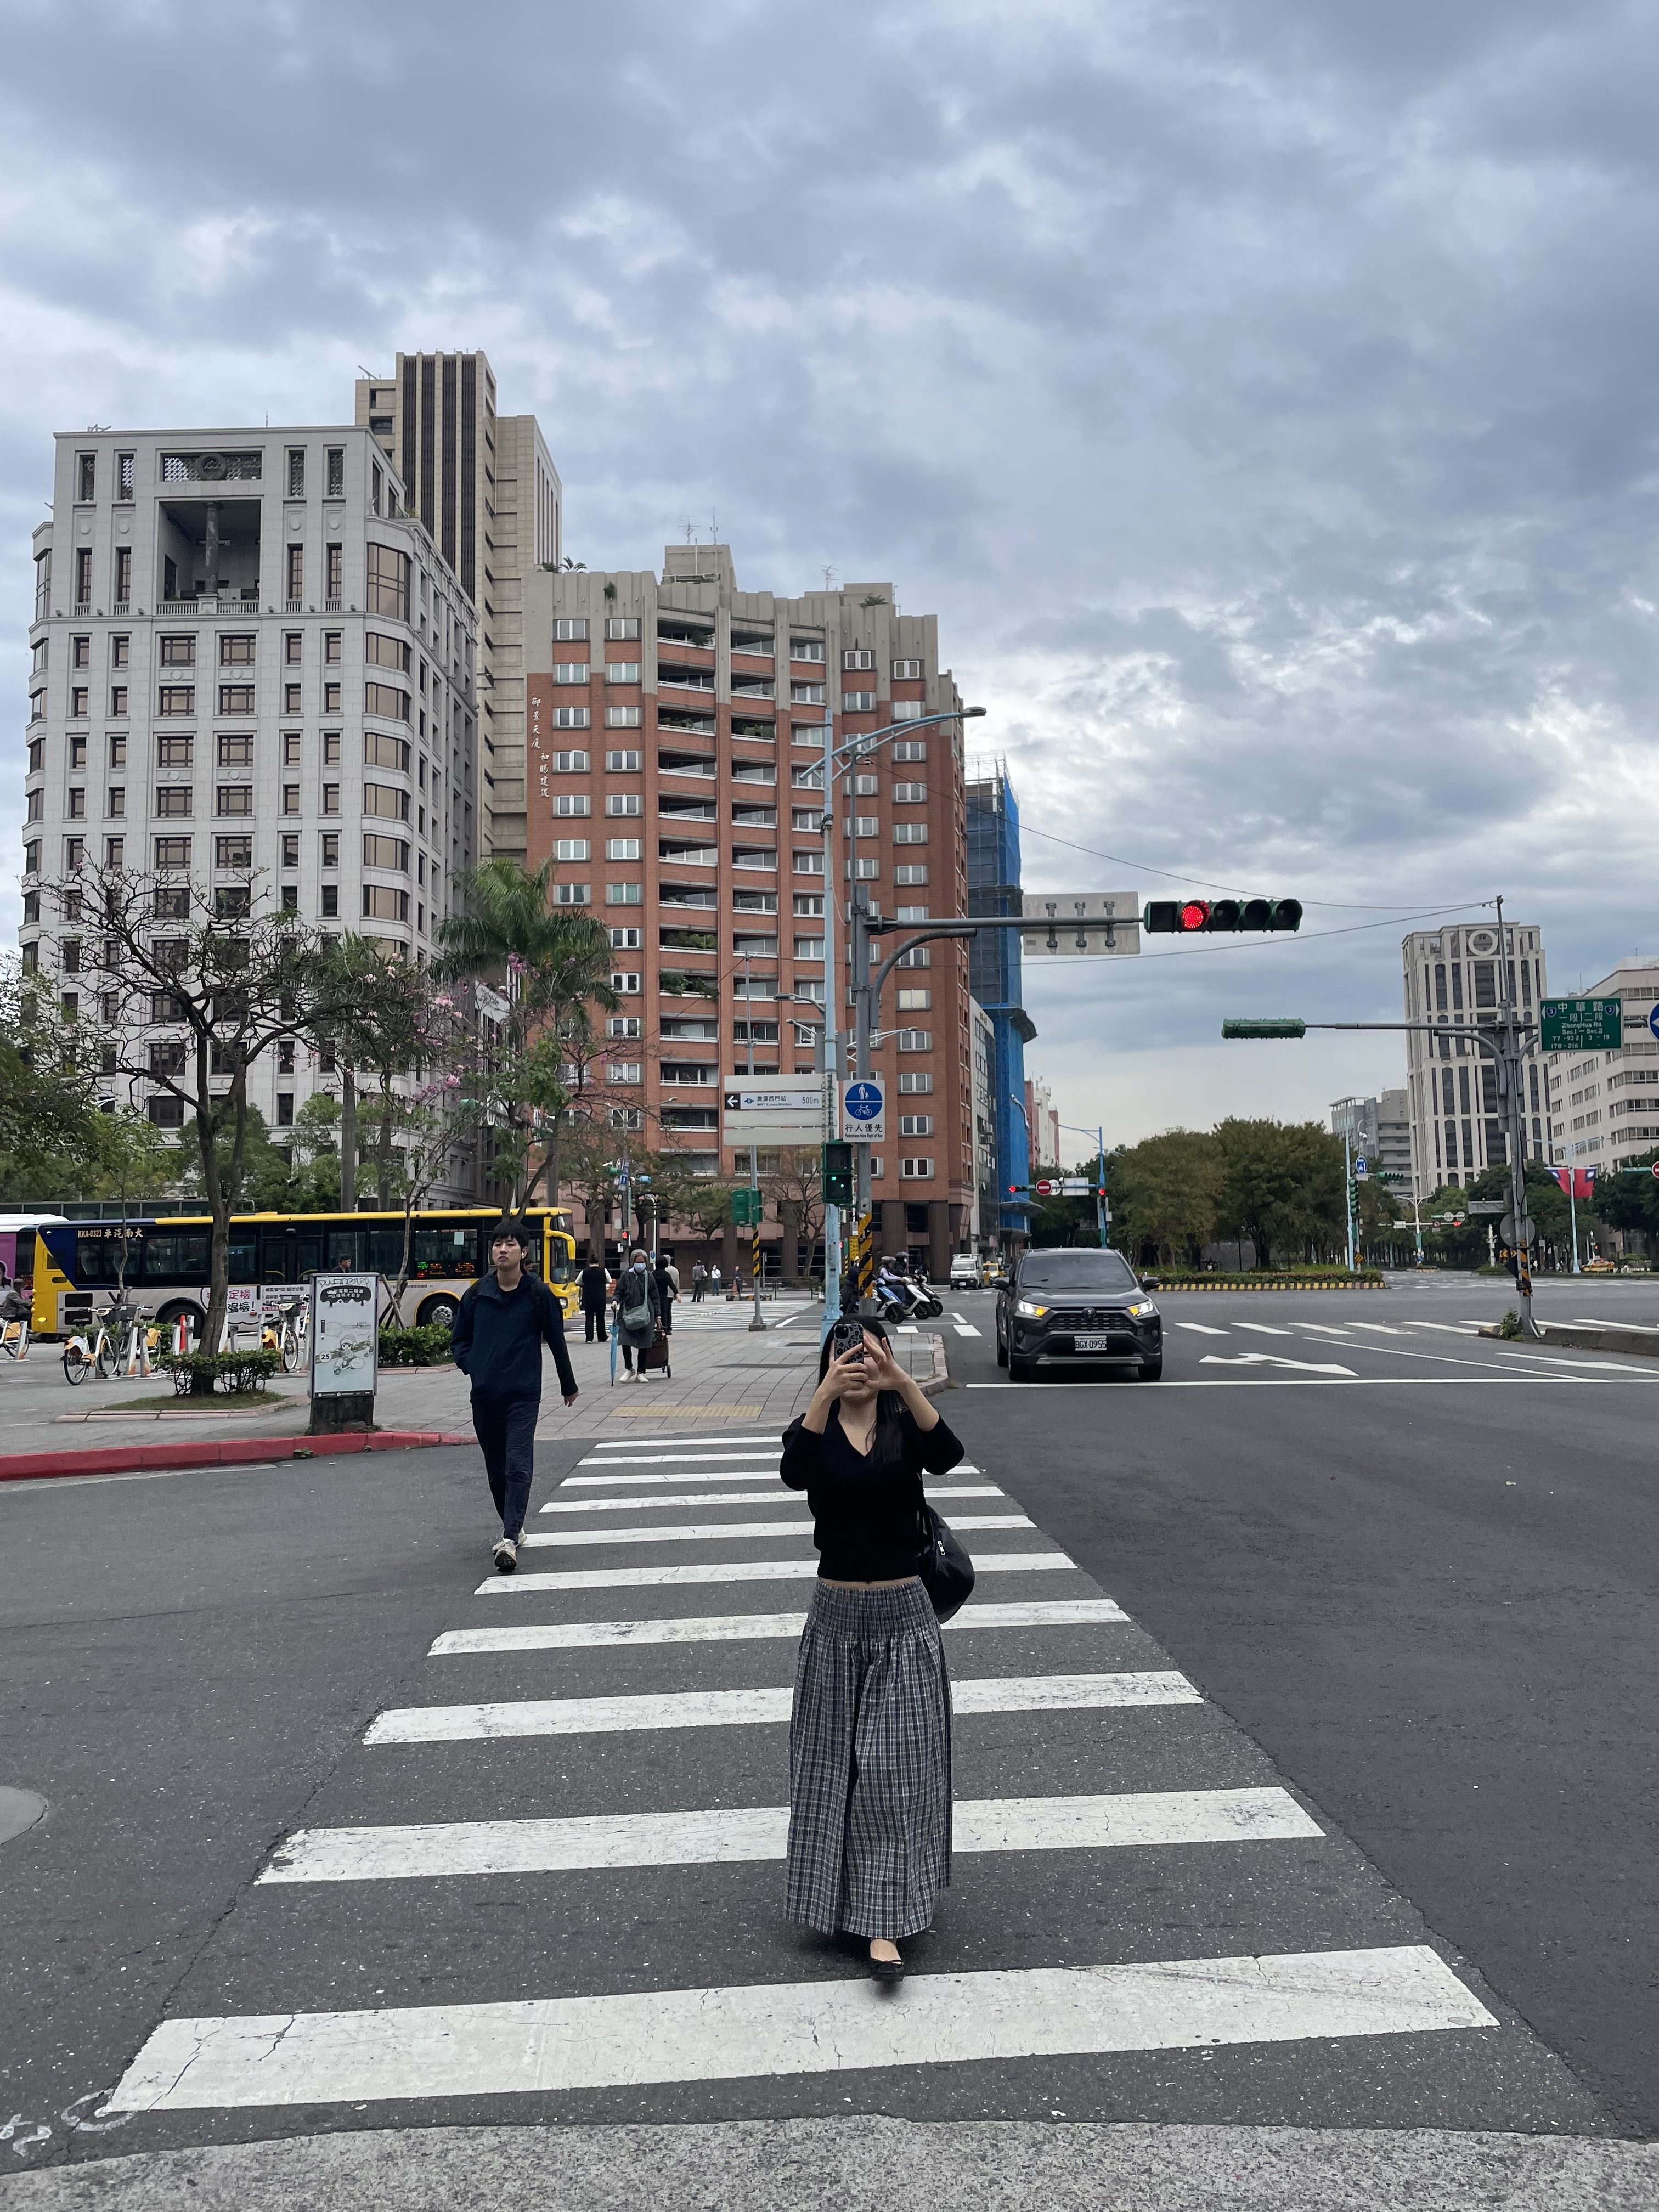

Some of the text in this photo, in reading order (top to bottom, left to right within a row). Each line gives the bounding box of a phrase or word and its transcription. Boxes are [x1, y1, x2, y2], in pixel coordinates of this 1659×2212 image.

[1558, 1001, 1604, 1013] 中華路
[1559, 1013, 1578, 1022] 一段
[1584, 1012, 1603, 1021] 二段
[845, 1124, 883, 1132] 行人優先
[78, 1229, 101, 1238] KKA-0323
